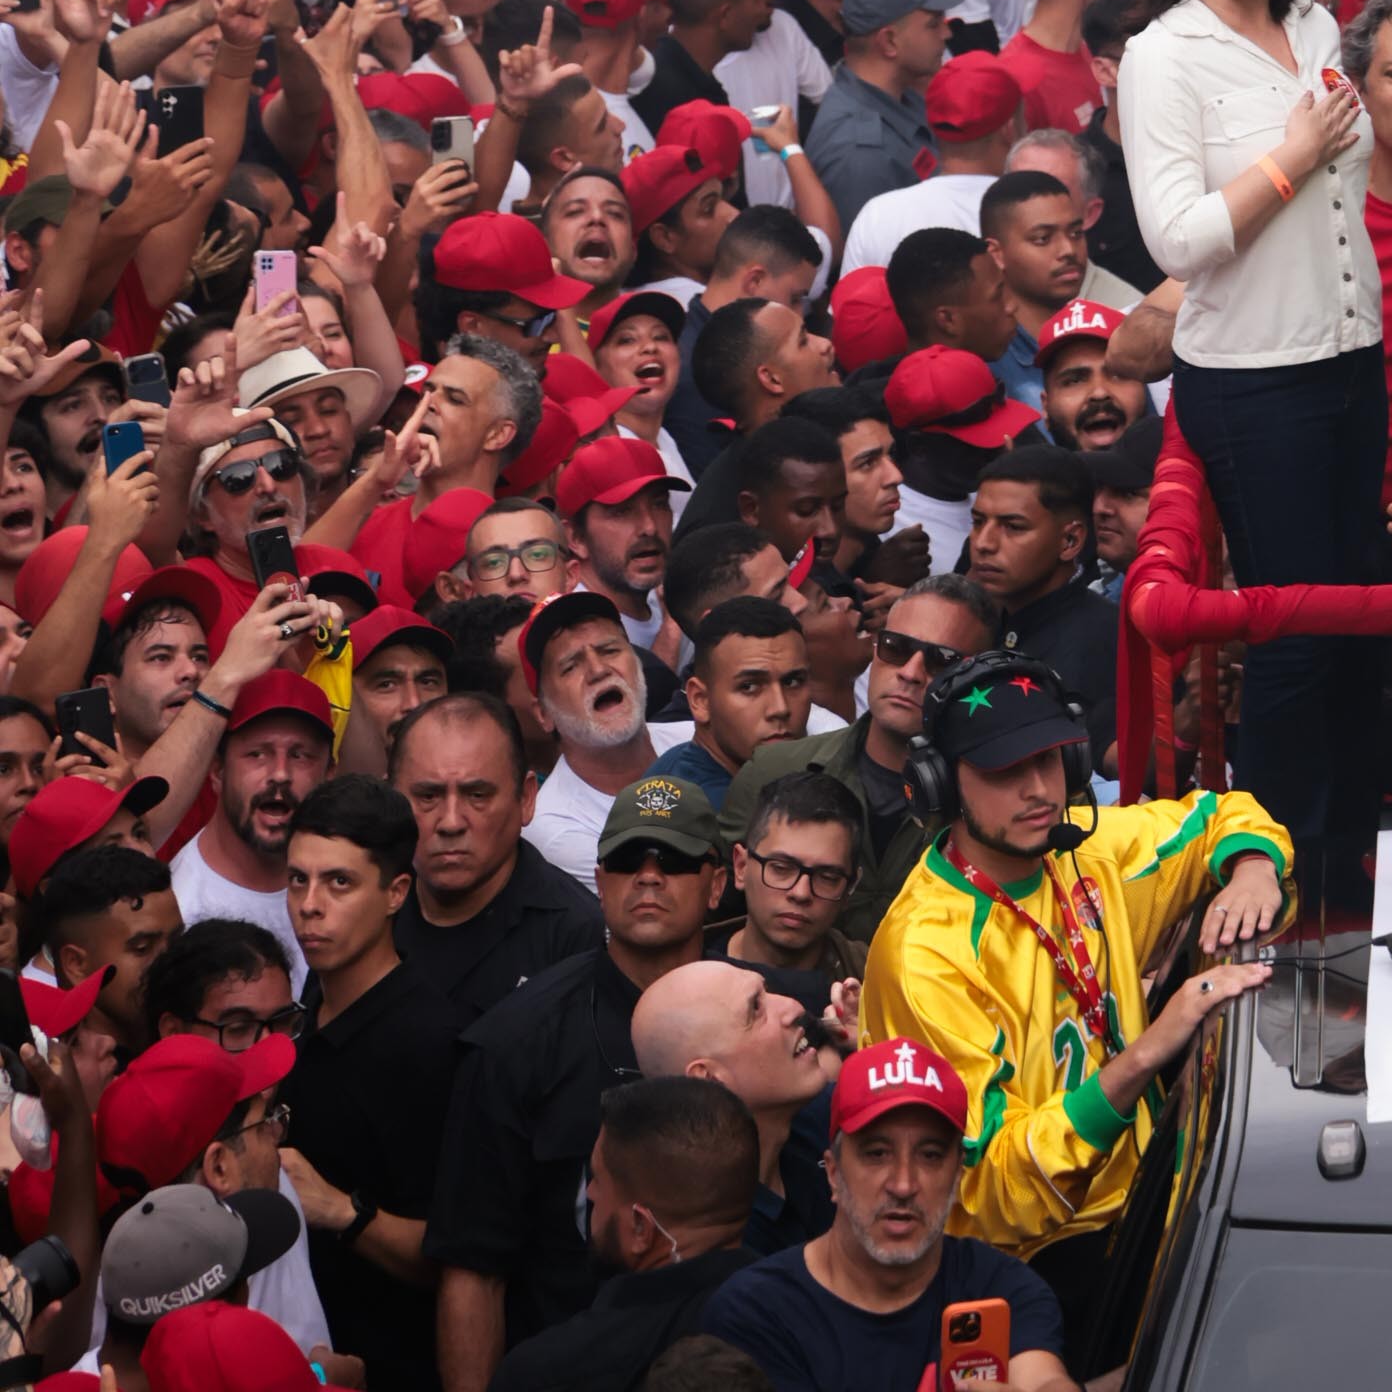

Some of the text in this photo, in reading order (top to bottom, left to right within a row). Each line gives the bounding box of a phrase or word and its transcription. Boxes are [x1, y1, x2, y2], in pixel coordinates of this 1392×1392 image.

[1053, 311, 1109, 338] LULA
[868, 1059, 944, 1093] LULA
[120, 1263, 227, 1316] QUIKSILVER
